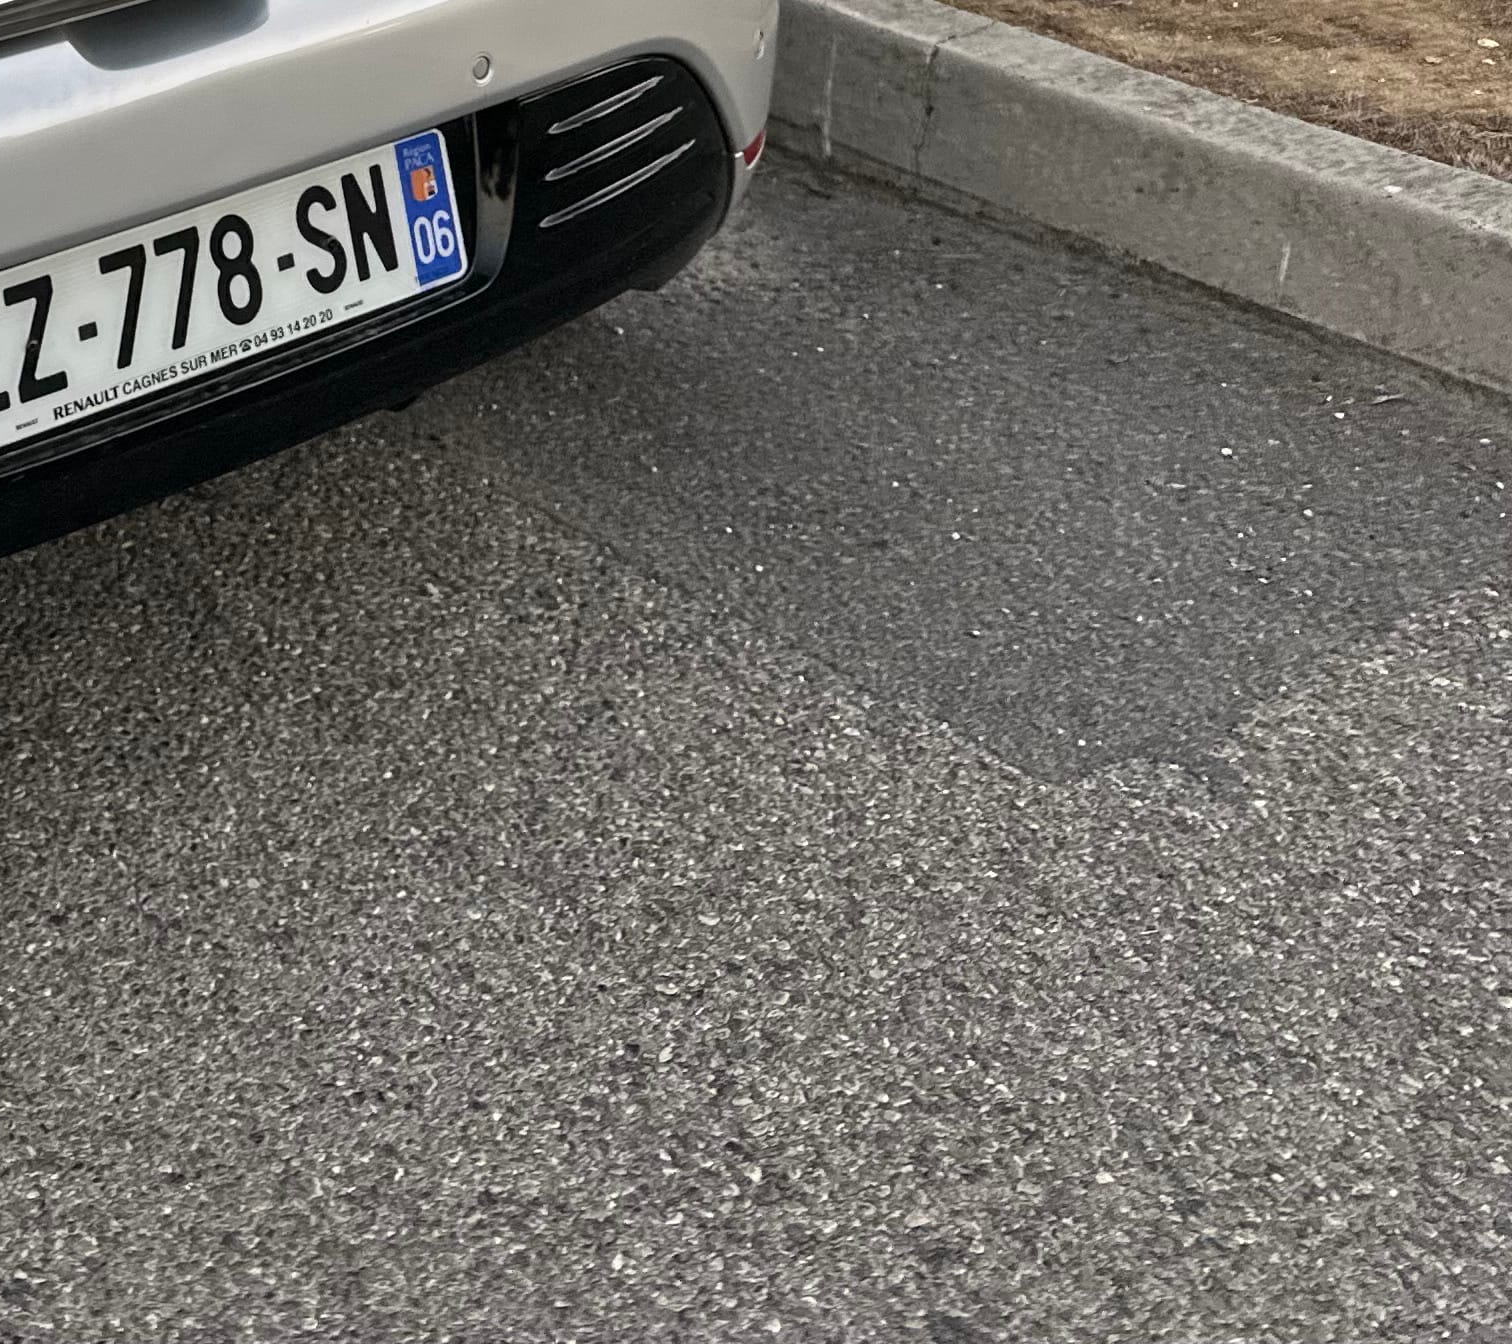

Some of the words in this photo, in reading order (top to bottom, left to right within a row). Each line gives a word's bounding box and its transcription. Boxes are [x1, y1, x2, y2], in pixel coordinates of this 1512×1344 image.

[413, 209, 455, 265] 06
[53, 385, 121, 421] RENAULT
[122, 365, 179, 396] CAGNES
[180, 354, 208, 376] SUR
[210, 344, 239, 368] MER
[253, 331, 269, 348] 04
[271, 325, 285, 343] 93
[287, 319, 302, 336] 14
[303, 313, 318, 331] 20
[319, 307, 334, 324] 20
